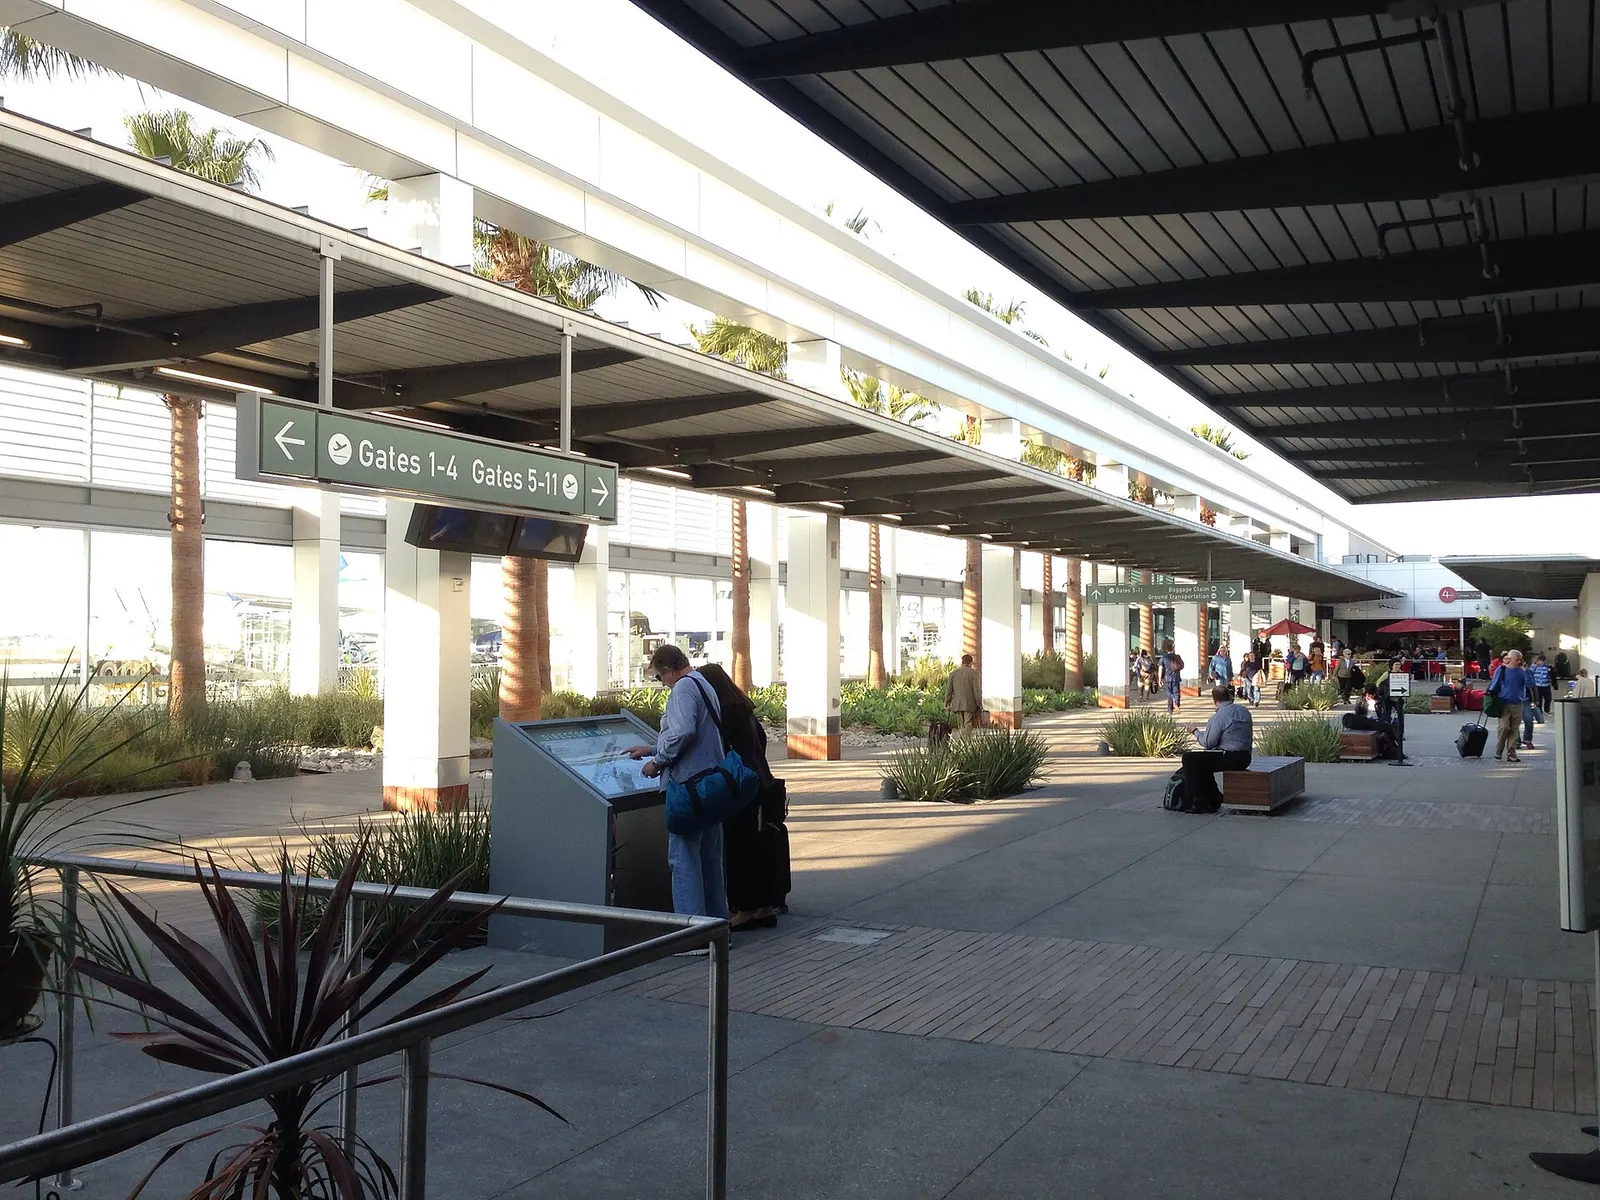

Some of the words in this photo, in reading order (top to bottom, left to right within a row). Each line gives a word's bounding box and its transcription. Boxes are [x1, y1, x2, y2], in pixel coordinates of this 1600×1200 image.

[359, 439, 421, 475] Gates
[428, 451, 458, 480] 1-4
[472, 458, 523, 492] Gates
[527, 469, 558, 496] 5-11
[541, 731, 592, 740] DIRECTORY
